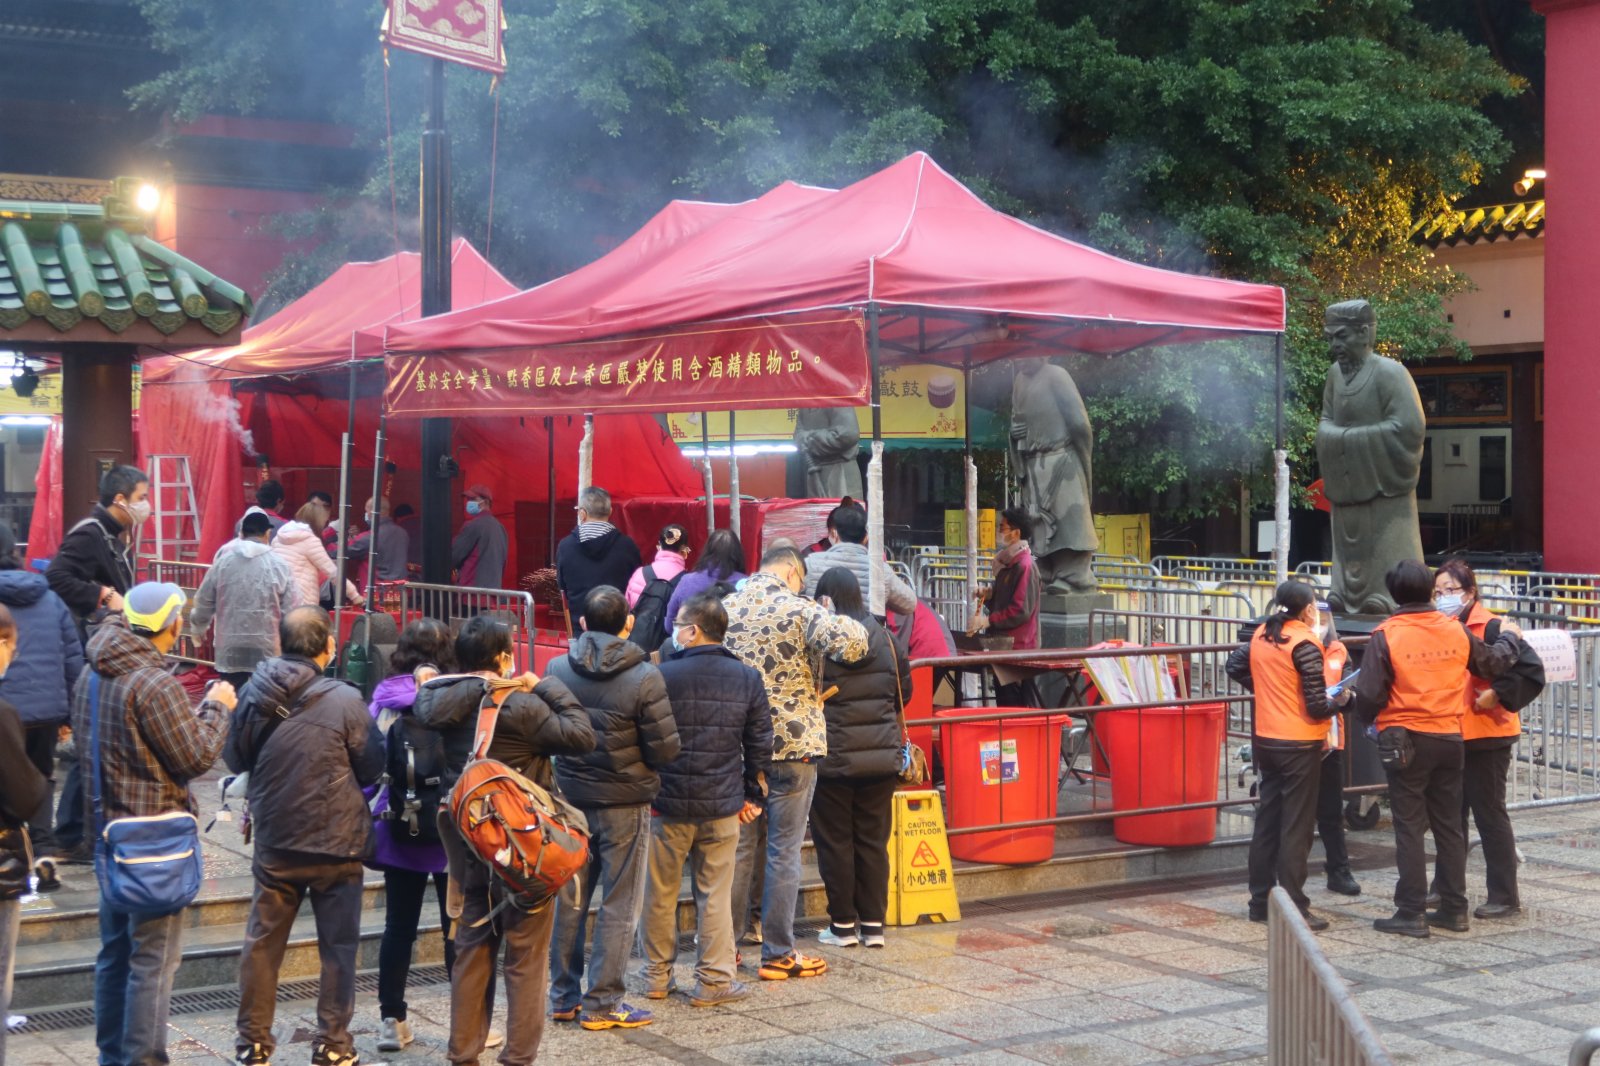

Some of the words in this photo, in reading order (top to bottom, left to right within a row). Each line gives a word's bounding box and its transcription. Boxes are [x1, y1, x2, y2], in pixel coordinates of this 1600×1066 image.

[907, 821, 937, 829] CAUTION
[904, 829, 918, 837] WET
[919, 827, 941, 835] FLOOR
[907, 868, 947, 886] 小心地滑
